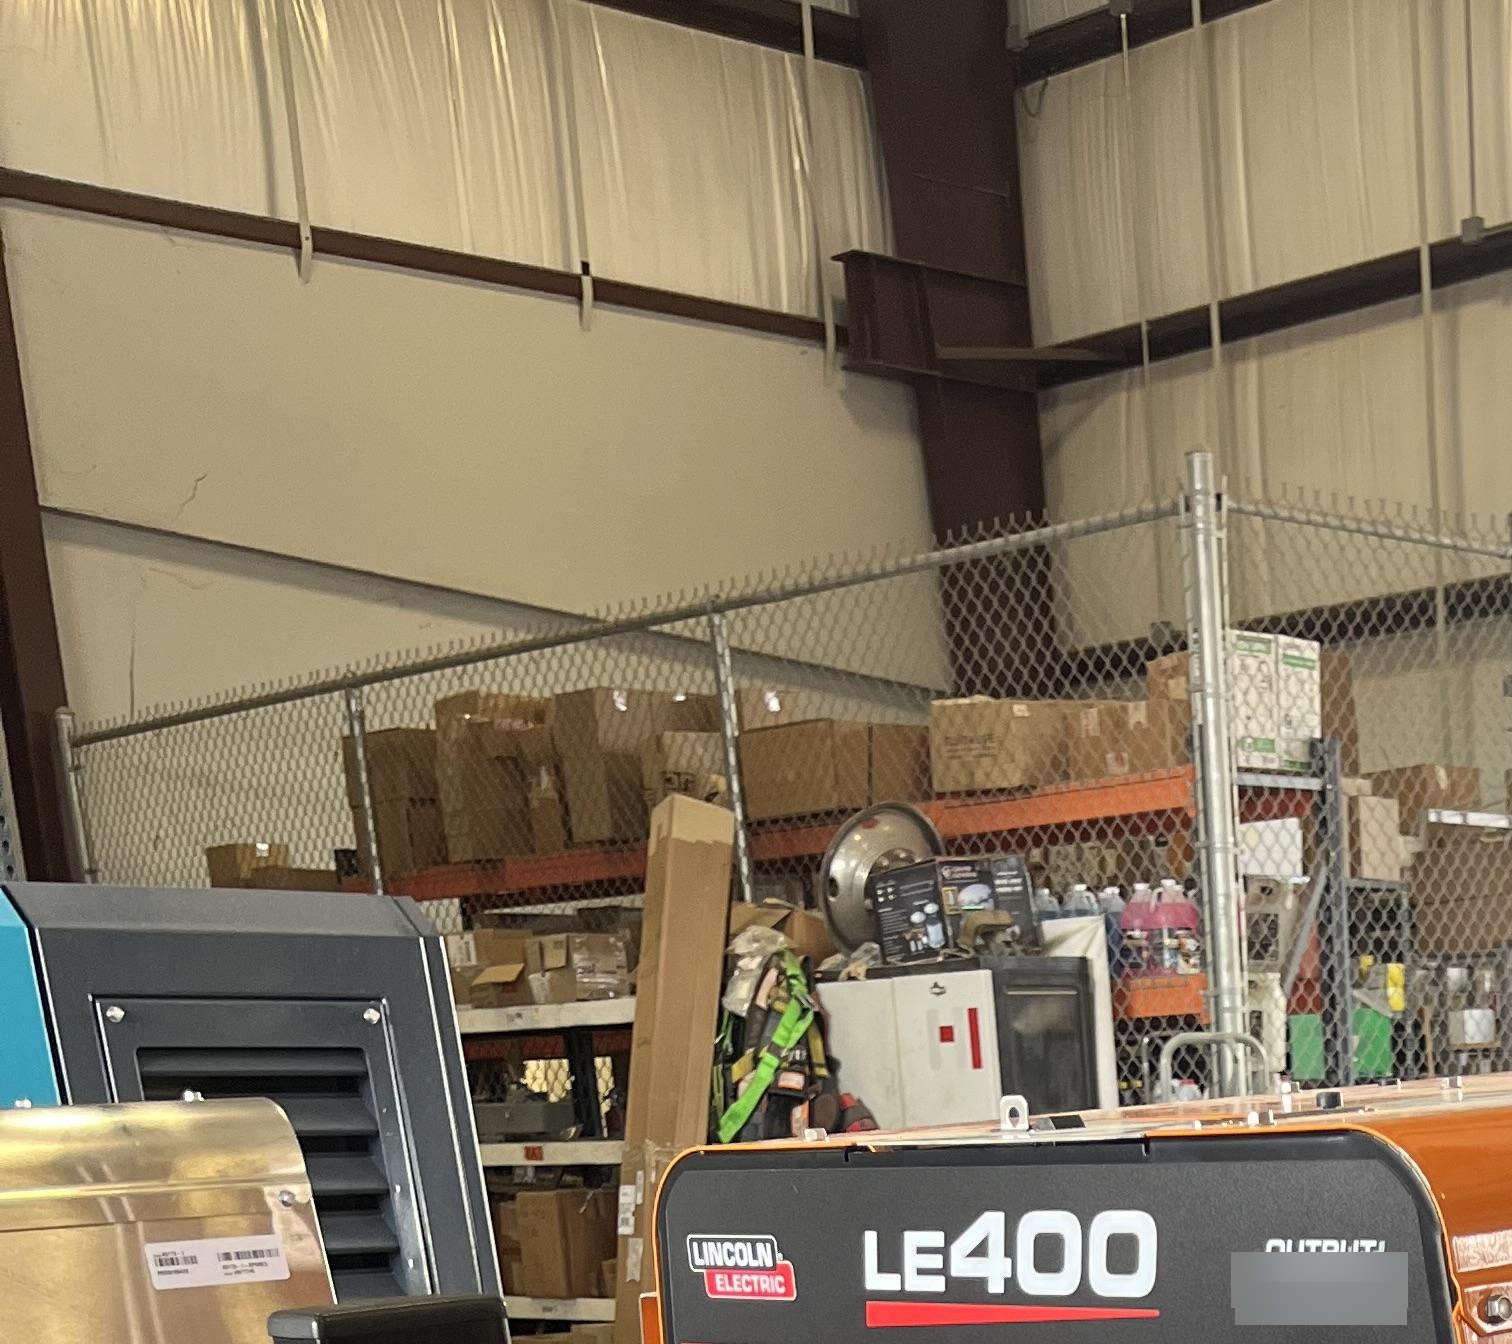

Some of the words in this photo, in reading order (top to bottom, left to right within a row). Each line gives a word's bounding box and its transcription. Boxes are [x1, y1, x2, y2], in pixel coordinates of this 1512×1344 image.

[692, 1241, 774, 1267] LINCOLN
[863, 1210, 1158, 1298] LE400
[715, 1273, 786, 1294] ELECTRIC
